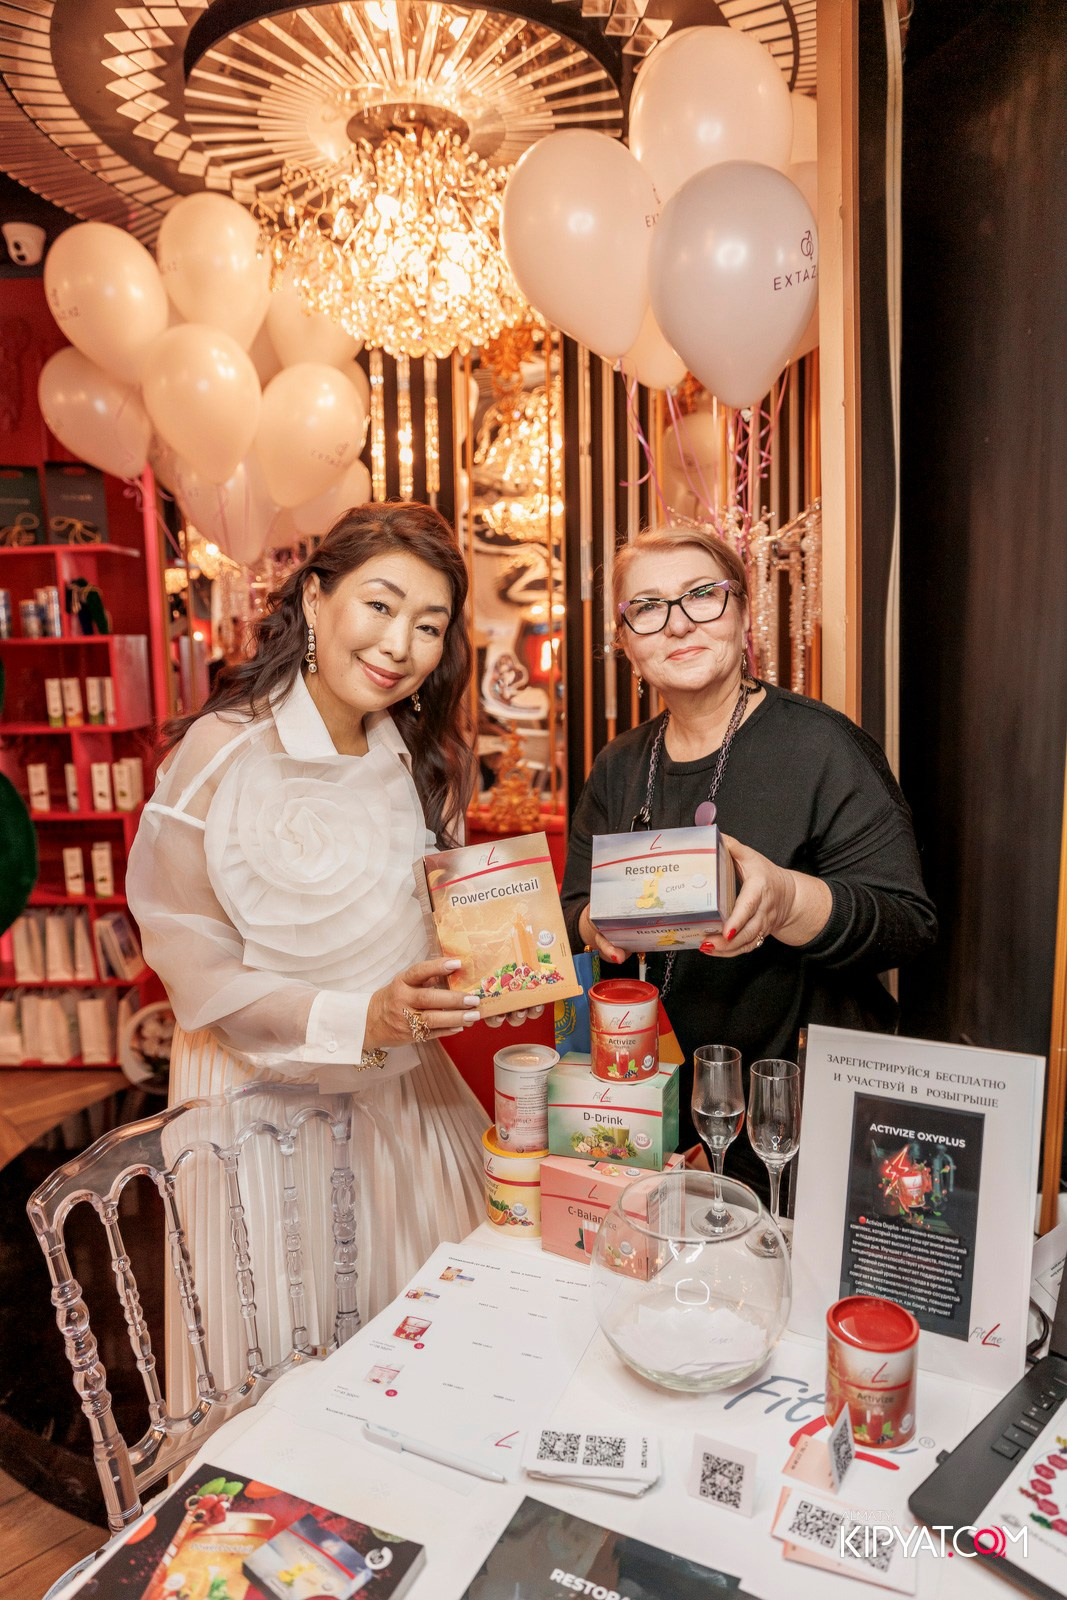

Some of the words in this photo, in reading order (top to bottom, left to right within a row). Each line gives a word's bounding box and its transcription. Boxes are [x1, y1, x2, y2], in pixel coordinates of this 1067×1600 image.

[773, 265, 818, 291] EXTAZ
[625, 863, 680, 876] Restorate
[451, 879, 539, 907] PowerCocktail
[665, 882, 686, 893] Citrus
[636, 927, 691, 935] Restorate
[608, 1038, 636, 1046] Activize
[827, 1054, 930, 1079] ЗАРЕГИСТРИРУЙСЯ
[936, 1071, 1006, 1091] БЕСПЛАТНО
[833, 1073, 841, 1082] И
[847, 1074, 905, 1093] УЧАСТВУЙ
[910, 1085, 918, 1094] В
[926, 1088, 999, 1108] РОЗЫГРЫШЕ
[583, 1111, 623, 1126] D-Drink
[869, 1123, 915, 1139] ACTIVIZE
[917, 1131, 966, 1148] OXYPLUS
[969, 1323, 1003, 1347] FitLine
[857, 1392, 895, 1403] Activize
[549, 1567, 631, 1600] RESTOR
